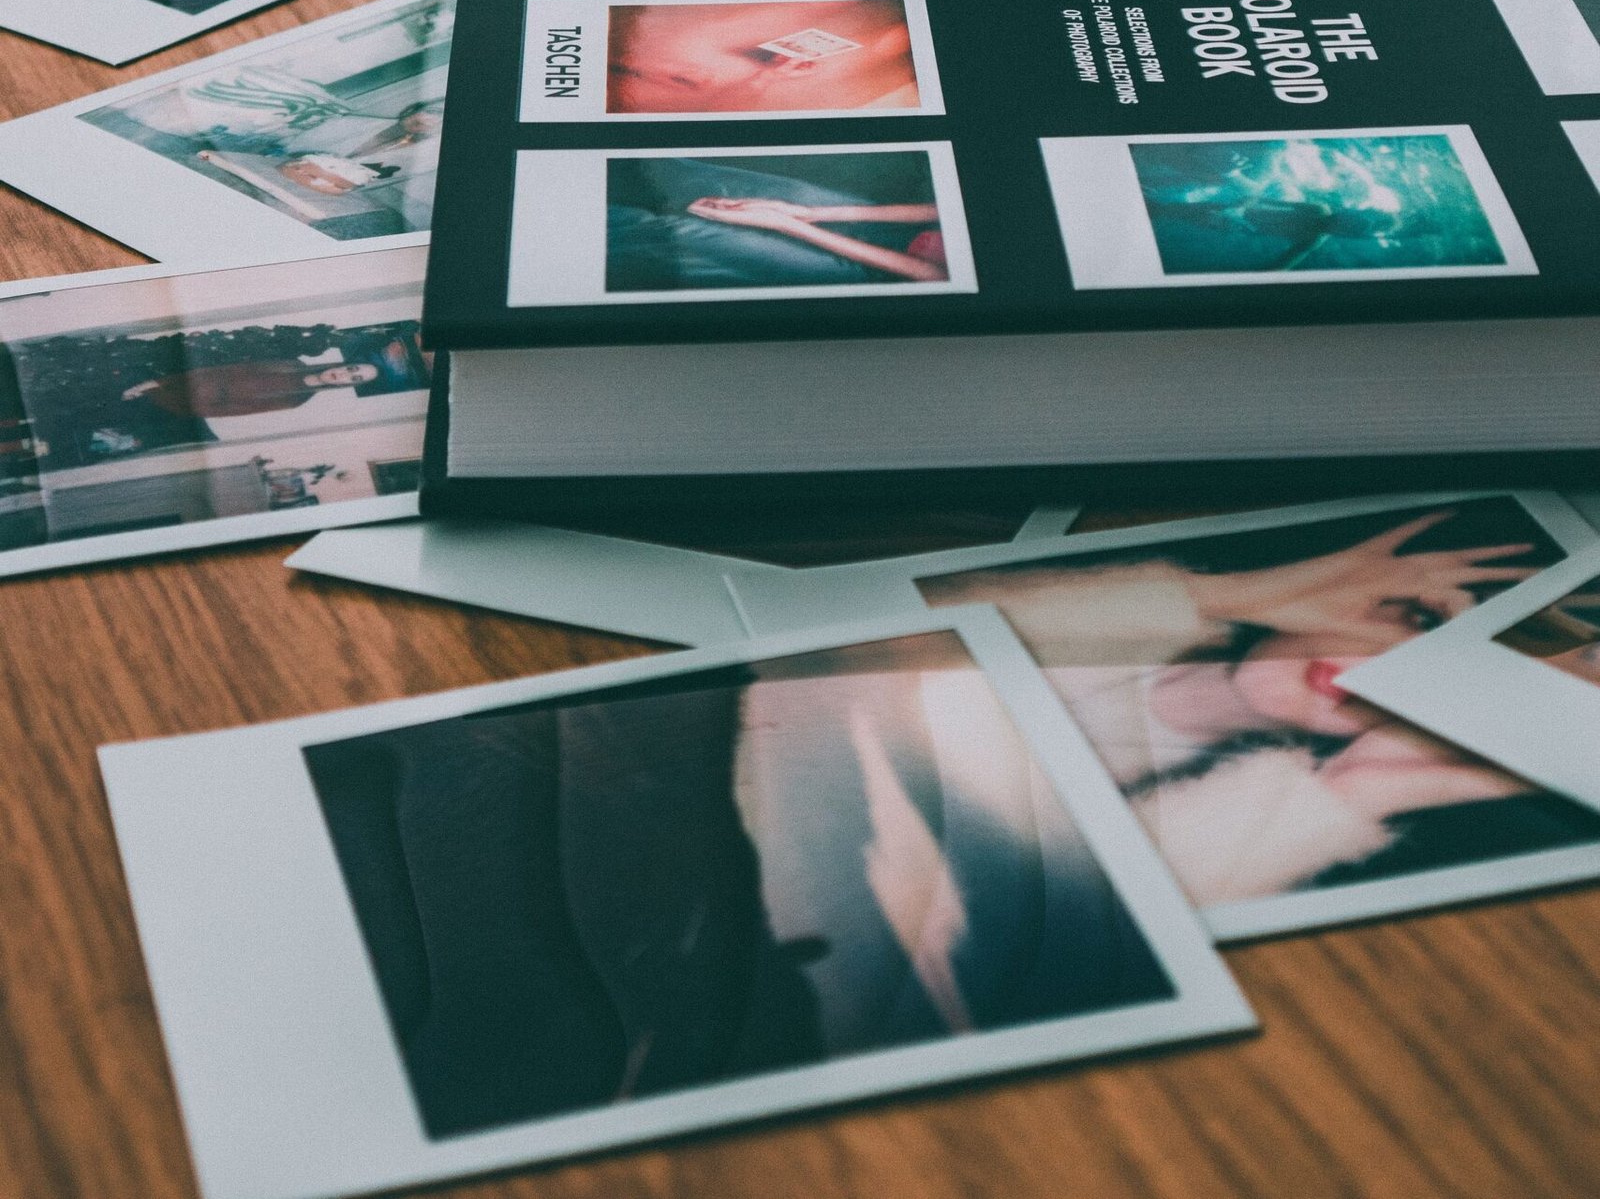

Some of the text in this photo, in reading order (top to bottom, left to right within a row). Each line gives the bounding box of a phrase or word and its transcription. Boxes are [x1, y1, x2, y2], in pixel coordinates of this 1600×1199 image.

[1062, 9, 1100, 83] OF PHOTOGRAPHY
[1093, 5, 1121, 45] POLAROID
[1124, 7, 1165, 82] SELECTIONS FROM
[1181, 7, 1256, 78] BOOK
[1310, 13, 1379, 62] THE
[544, 25, 582, 97] TASCHEN
[1104, 47, 1139, 104] COLLECTIONS
